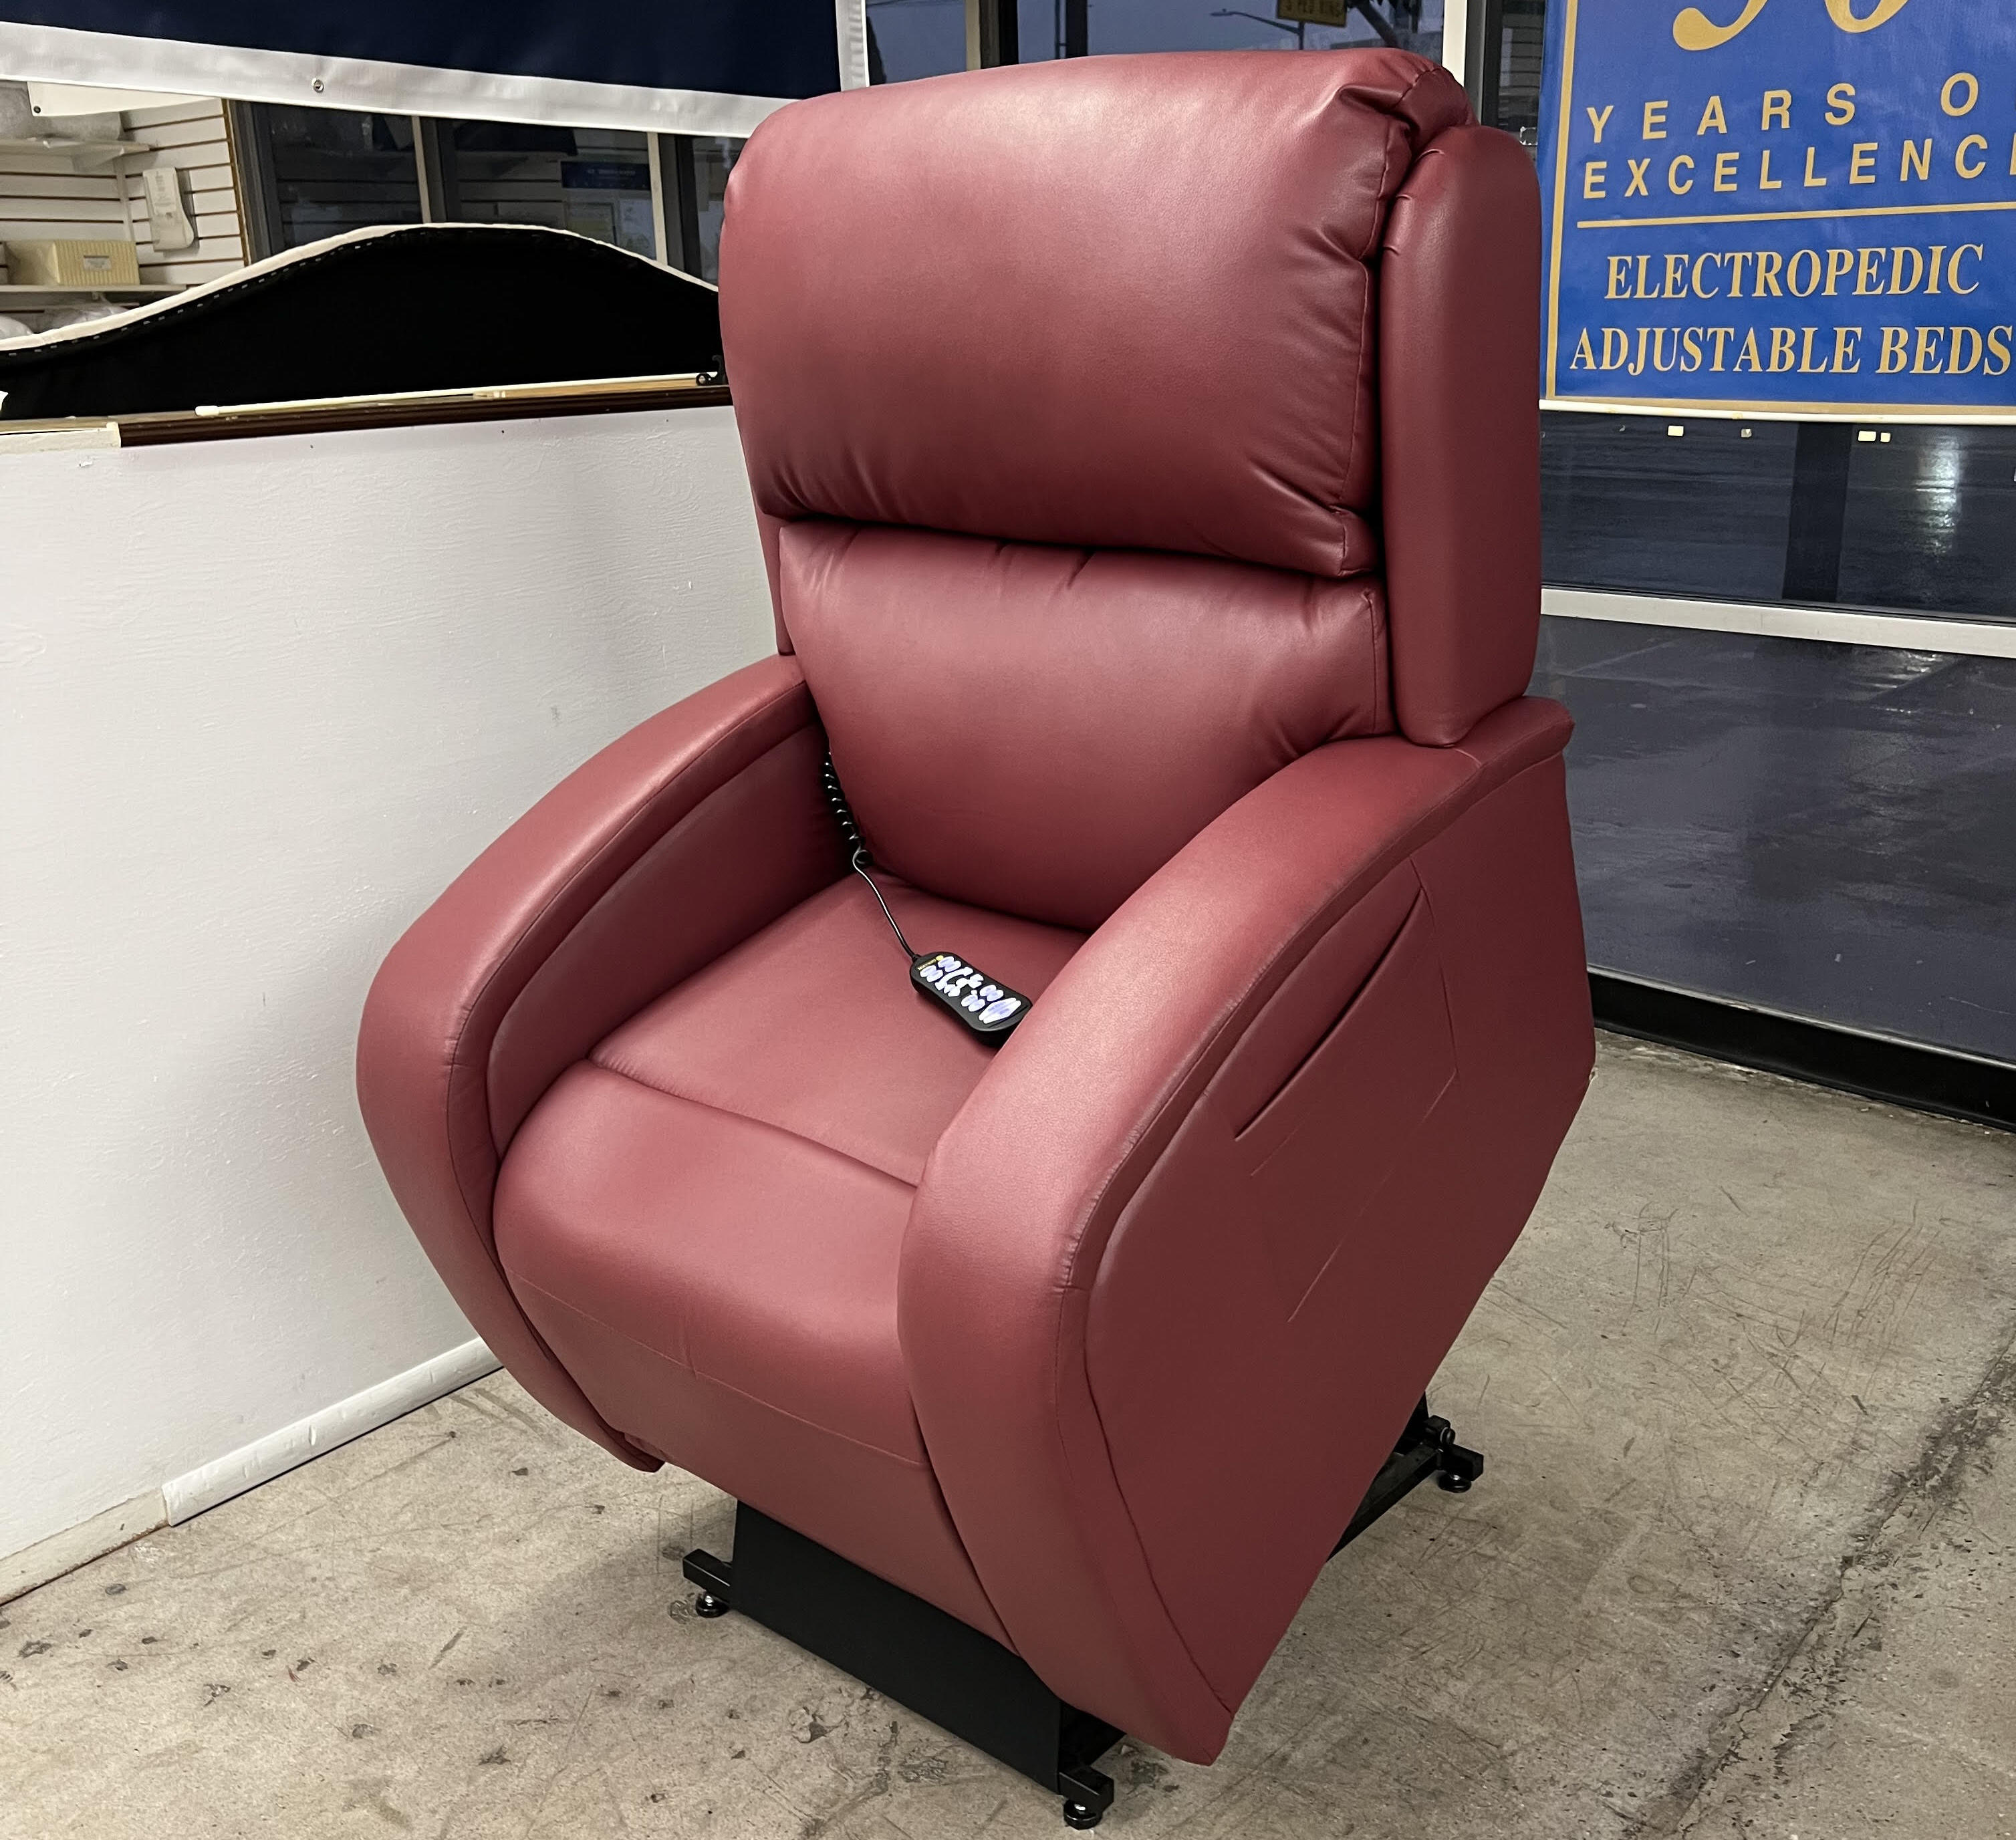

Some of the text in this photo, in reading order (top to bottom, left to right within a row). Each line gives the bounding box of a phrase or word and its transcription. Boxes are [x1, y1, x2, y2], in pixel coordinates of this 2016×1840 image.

[1586, 82, 1857, 144] YEARS
[1583, 133, 2016, 199] EXCELLENC
[1604, 243, 1984, 299] ELECTROPEDIC
[1569, 325, 2013, 376] ADJUSTABLE BEDS
